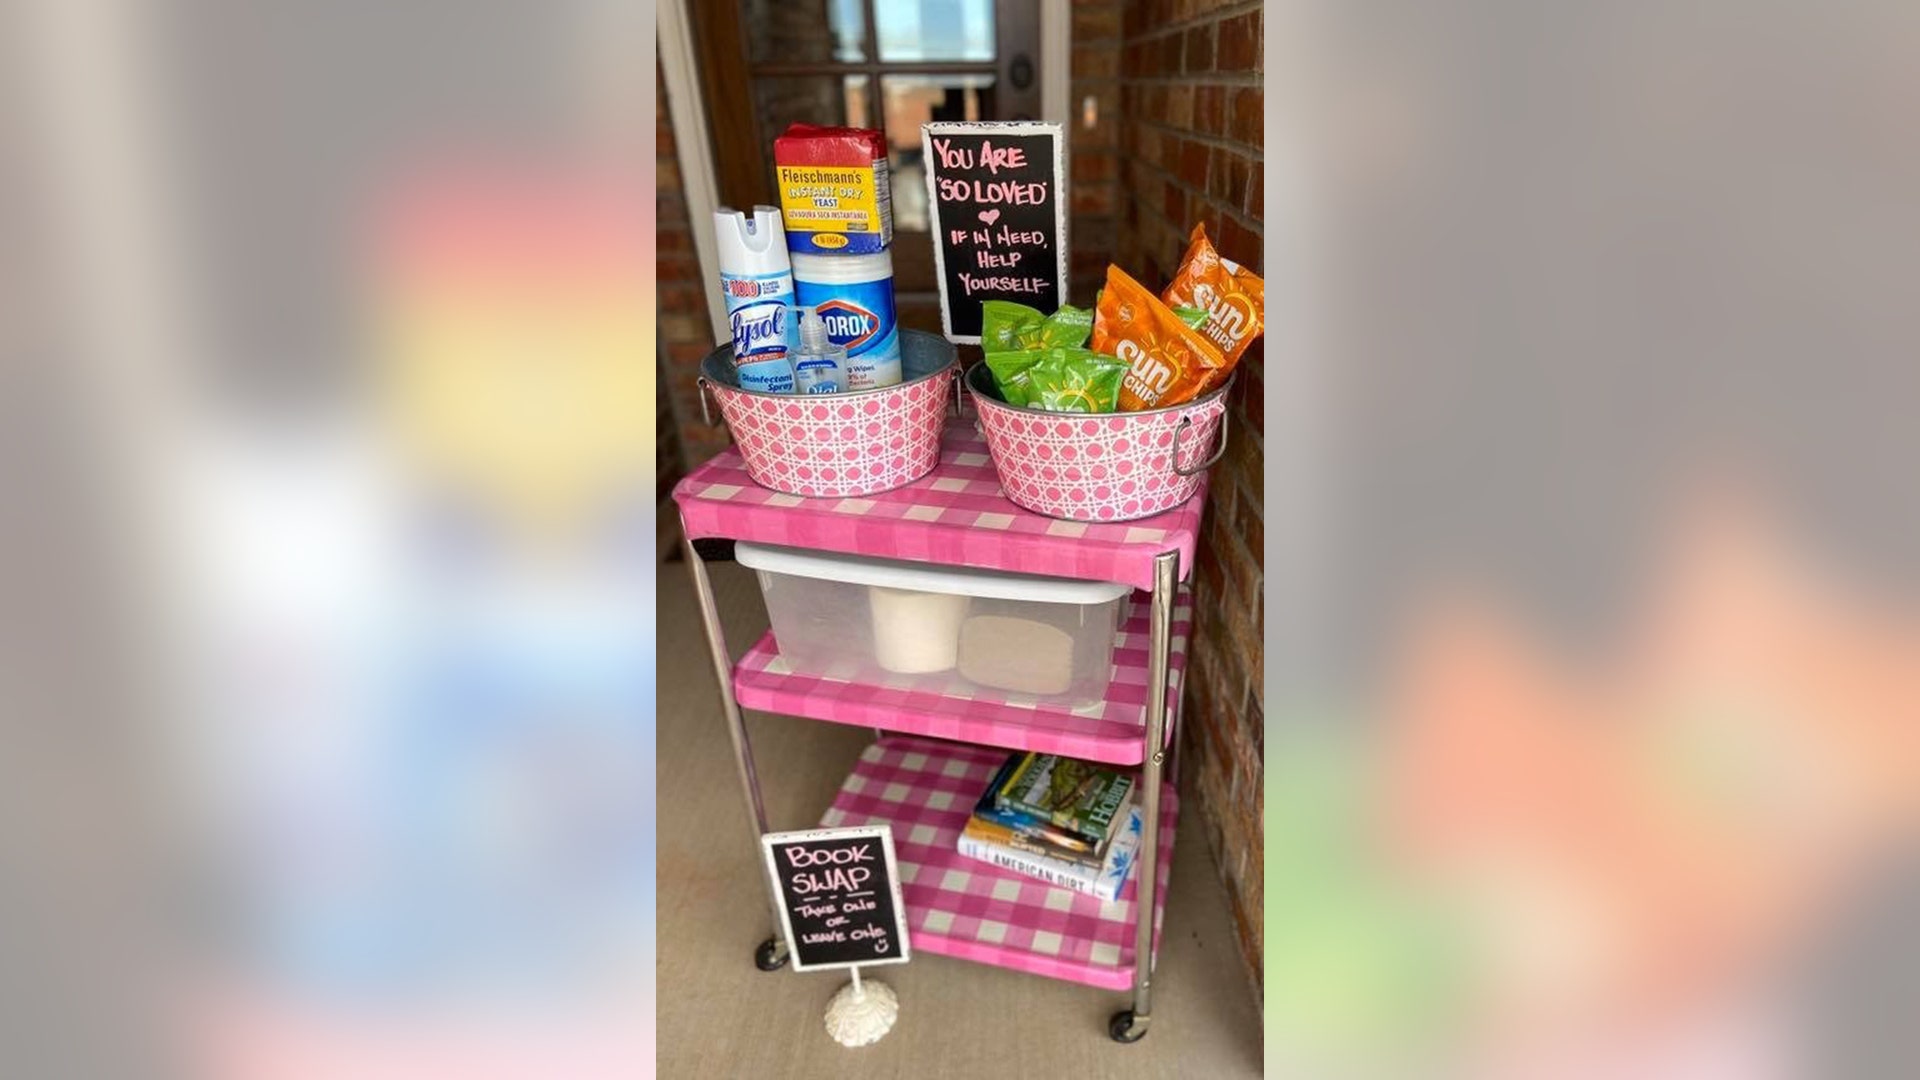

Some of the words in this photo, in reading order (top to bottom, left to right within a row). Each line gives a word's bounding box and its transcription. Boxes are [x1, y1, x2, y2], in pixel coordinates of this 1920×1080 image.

[933, 138, 974, 170] YOU
[980, 140, 1028, 175] ARE
[782, 168, 862, 184] Fleischmann's
[788, 186, 836, 199] INSTANT
[840, 187, 864, 200] DRY
[813, 198, 838, 207] YEAST
[951, 229, 968, 246] IF
[973, 228, 992, 249] IN
[996, 224, 1048, 250] NEED,
[977, 250, 1022, 269] HELP
[732, 305, 780, 353] Lysol
[826, 313, 871, 336] OROX
[742, 373, 792, 385] Disinfectant
[767, 382, 793, 393] Spray
[1089, 775, 1132, 826] HOBBIT
[785, 844, 875, 867] BOOK
[791, 866, 871, 894] SWAP
[993, 853, 1053, 881] AMERICAN
[1057, 874, 1085, 890] DIRT
[793, 904, 837, 918] TAKE
[825, 916, 850, 928] OR
[801, 930, 847, 944] LEAVE
